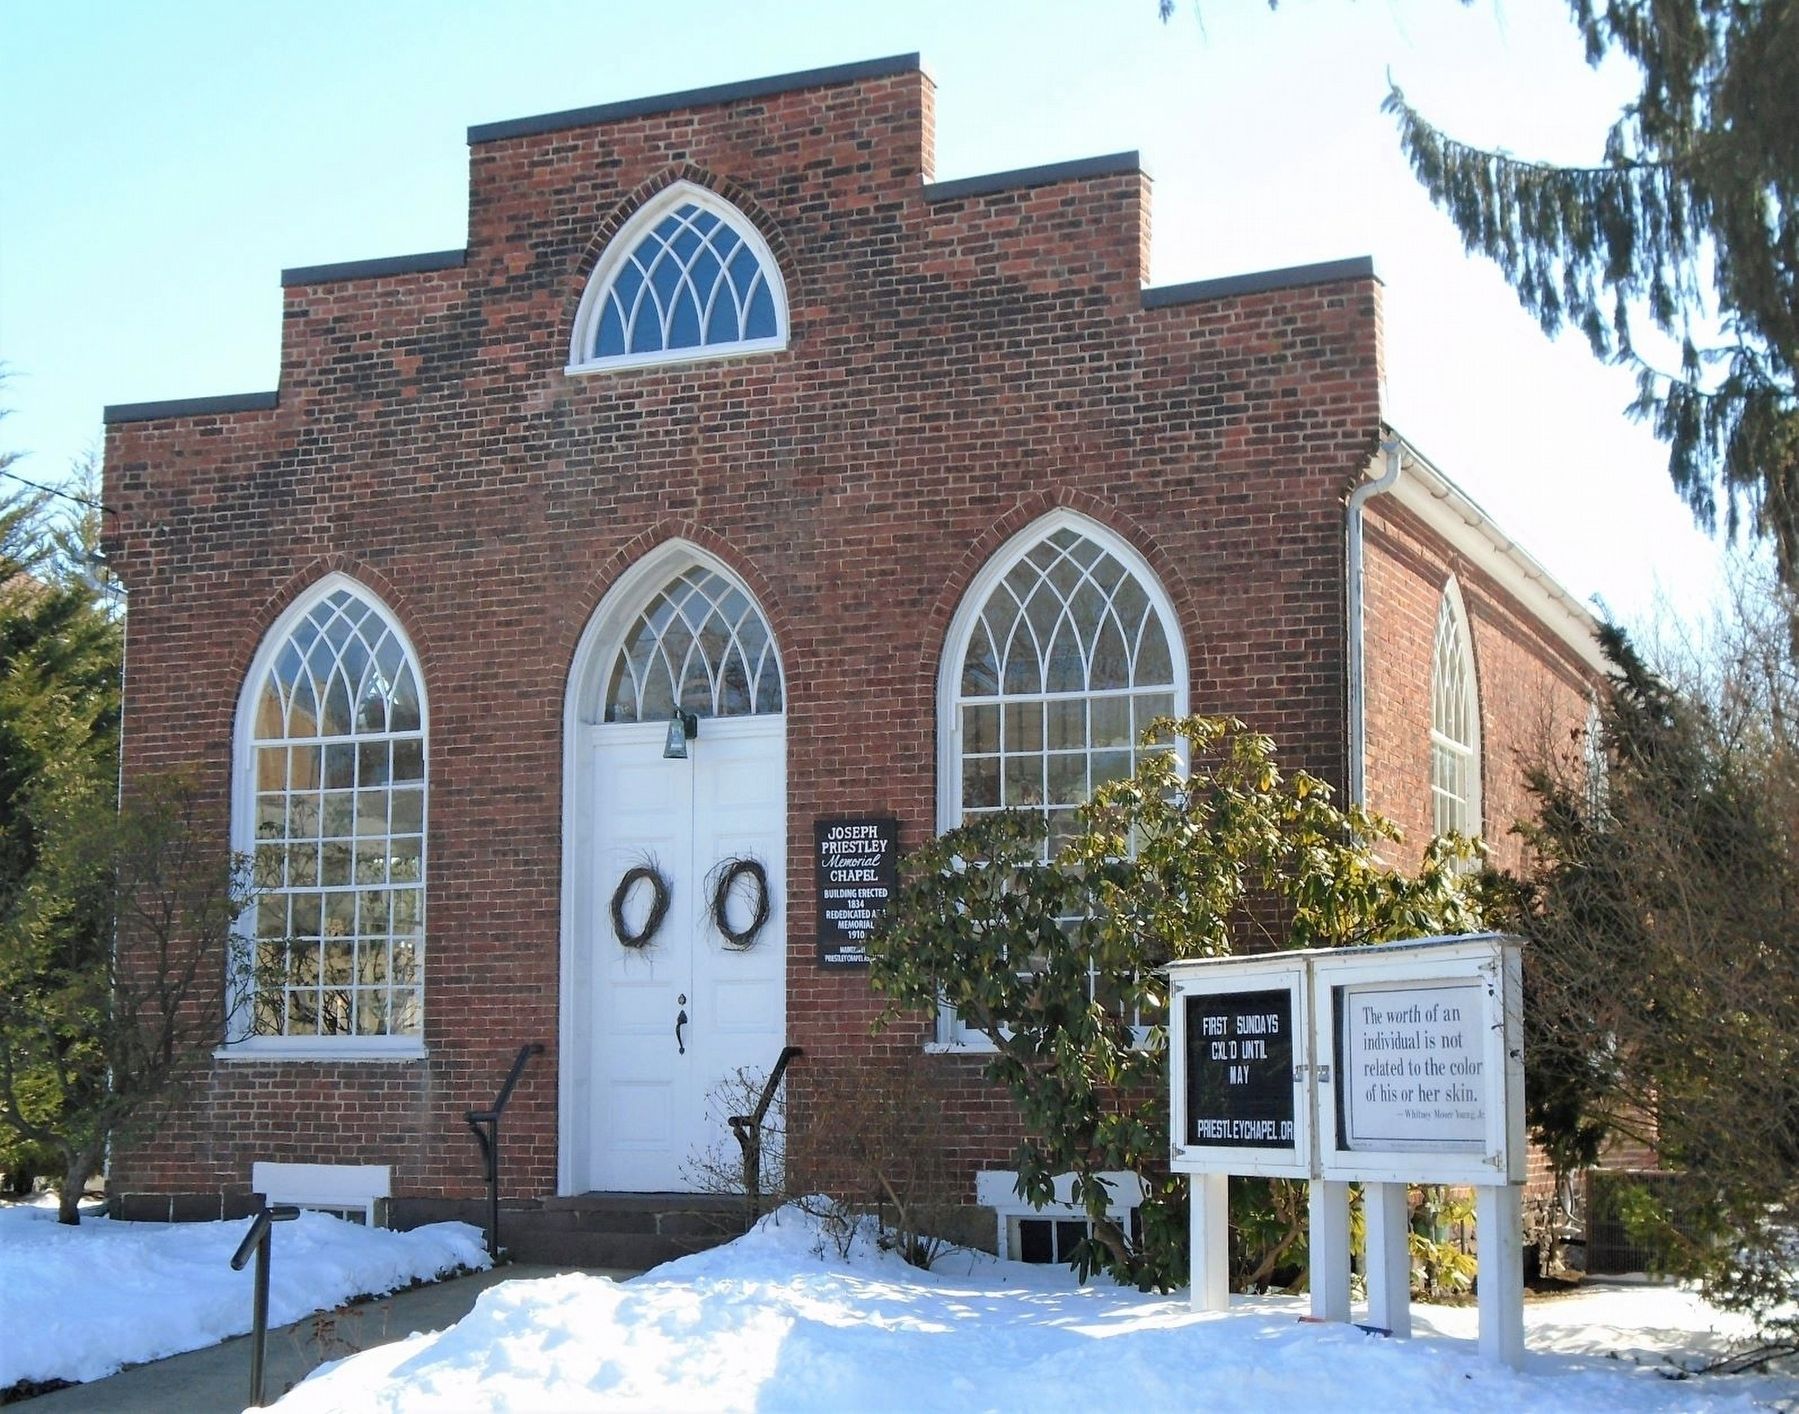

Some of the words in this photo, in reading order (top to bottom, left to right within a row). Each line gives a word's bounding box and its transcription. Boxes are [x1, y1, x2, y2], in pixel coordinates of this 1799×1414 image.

[828, 826, 878, 840] JOSEPH
[821, 840, 888, 854] PRIESTLEY
[821, 854, 881, 868] Memorial
[830, 869, 878, 882] CHAPEL
[824, 889, 857, 899] BUILDING
[858, 888, 888, 898] ERECTED
[847, 900, 865, 909] 1834
[825, 910, 871, 919] REDEDICATED
[838, 920, 875, 930] MEMORIAL
[847, 930, 865, 939] 1910
[1363, 1006, 1383, 1025] The
[1387, 1004, 1421, 1024] worth
[1425, 1003, 1440, 1022] of
[1443, 1008, 1461, 1022] an
[1203, 1017, 1228, 1036] FIRST
[1236, 1014, 1279, 1035] SUNDAYS
[1363, 1031, 1421, 1051] individual
[1424, 1031, 1436, 1049] is
[1441, 1031, 1463, 1049] not
[1212, 1041, 1237, 1061] CXL'D
[1242, 1040, 1268, 1060] UNTIL
[1364, 1057, 1404, 1077] related
[1408, 1058, 1421, 1076] to
[1425, 1057, 1446, 1076] the
[1449, 1056, 1483, 1076] color
[1229, 1065, 1250, 1085] MAY
[1366, 1084, 1377, 1102] of
[1380, 1083, 1397, 1102] his
[1401, 1088, 1414, 1102] or
[1418, 1084, 1441, 1102] her
[1445, 1083, 1478, 1102] skin.
